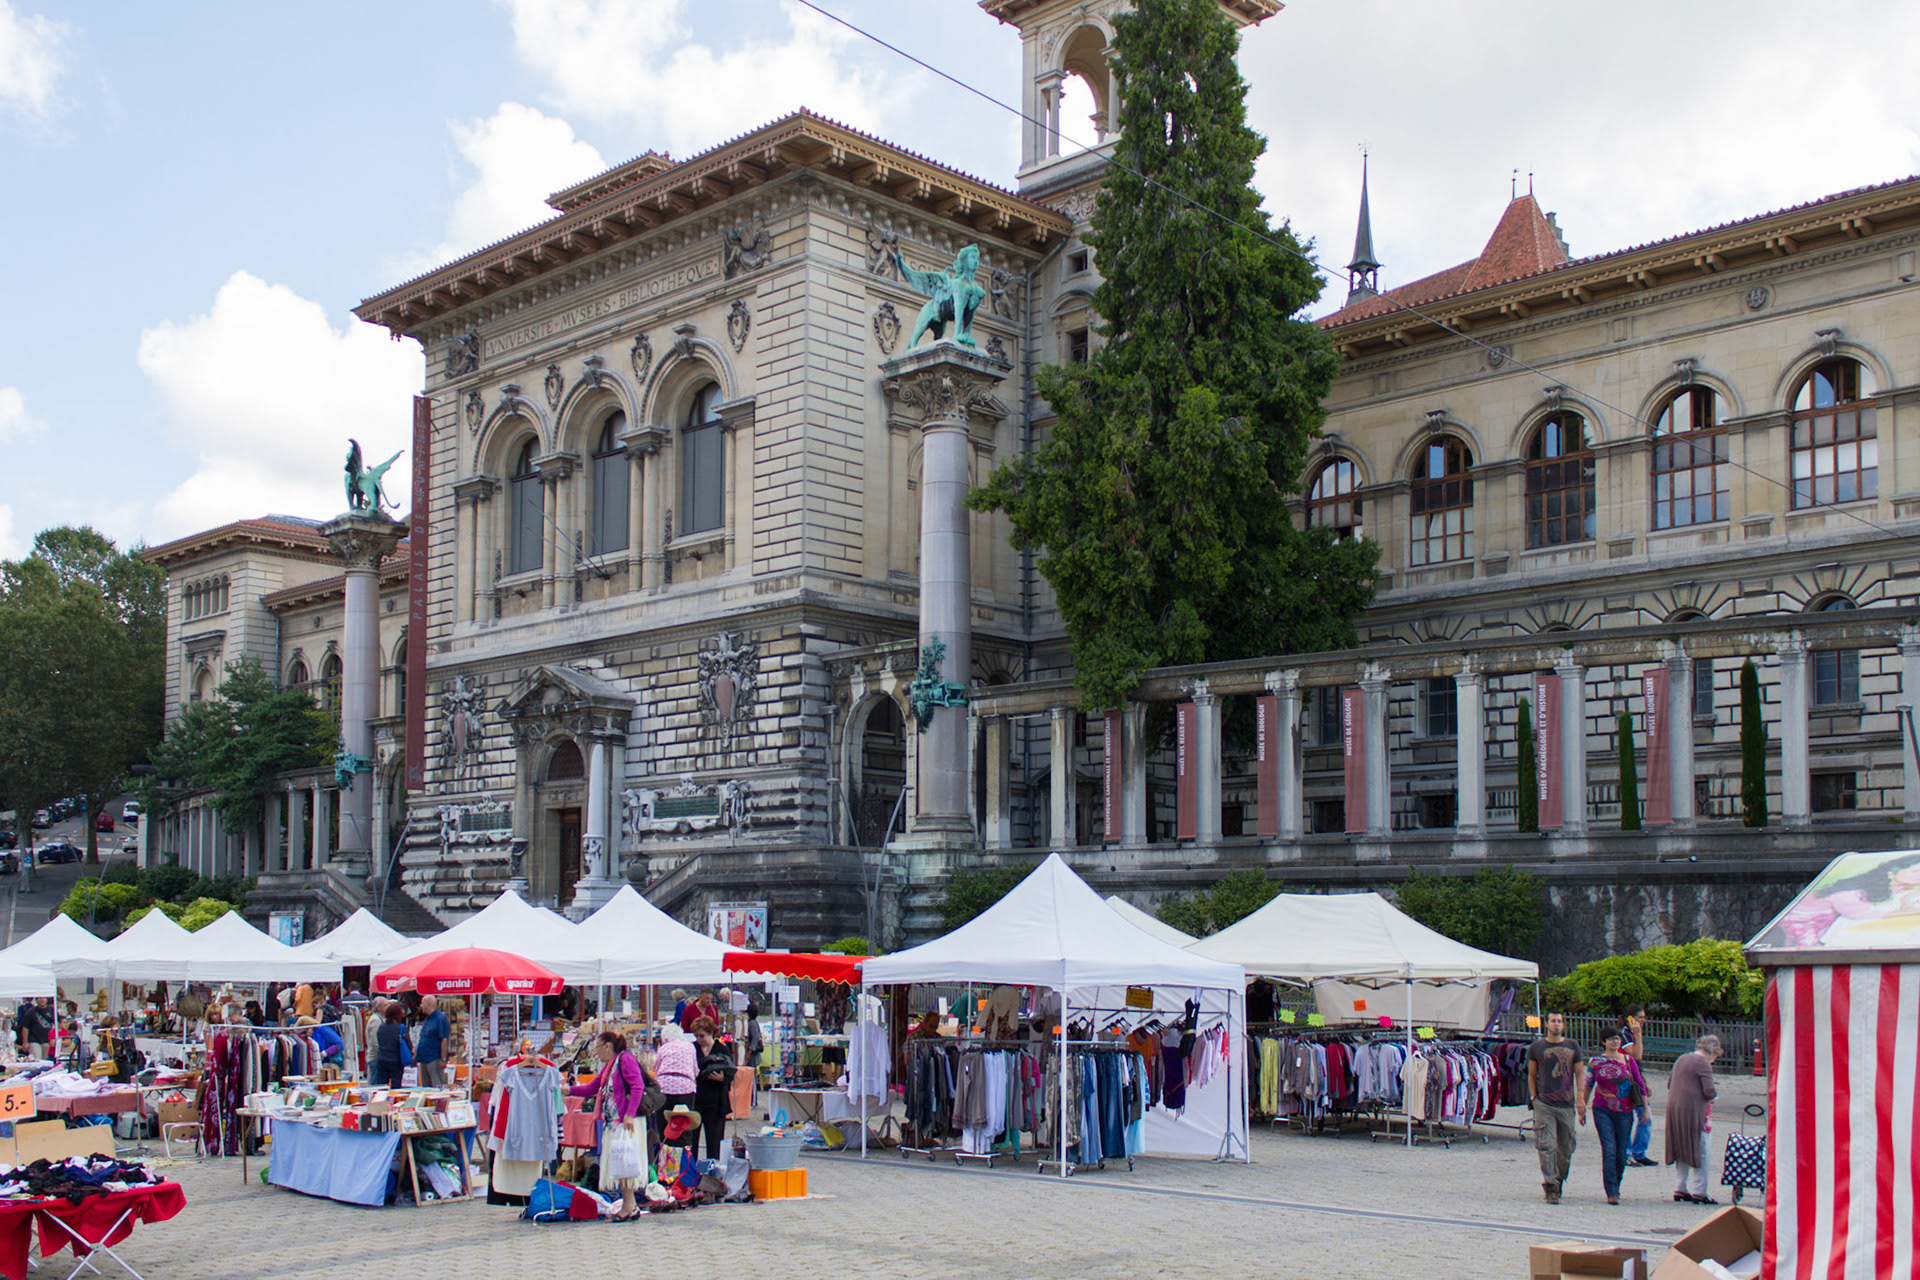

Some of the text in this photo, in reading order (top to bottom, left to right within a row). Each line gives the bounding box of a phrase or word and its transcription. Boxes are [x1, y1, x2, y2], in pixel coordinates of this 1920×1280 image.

[415, 512, 425, 534] DE
[413, 549, 424, 620] PALAIS
[1645, 677, 1655, 736] MUSÉE MONÉTAIRE
[1345, 727, 1352, 736] DE
[1539, 780, 1547, 800] MUSÉE
[436, 978, 471, 991] granini
[507, 978, 535, 990] granini
